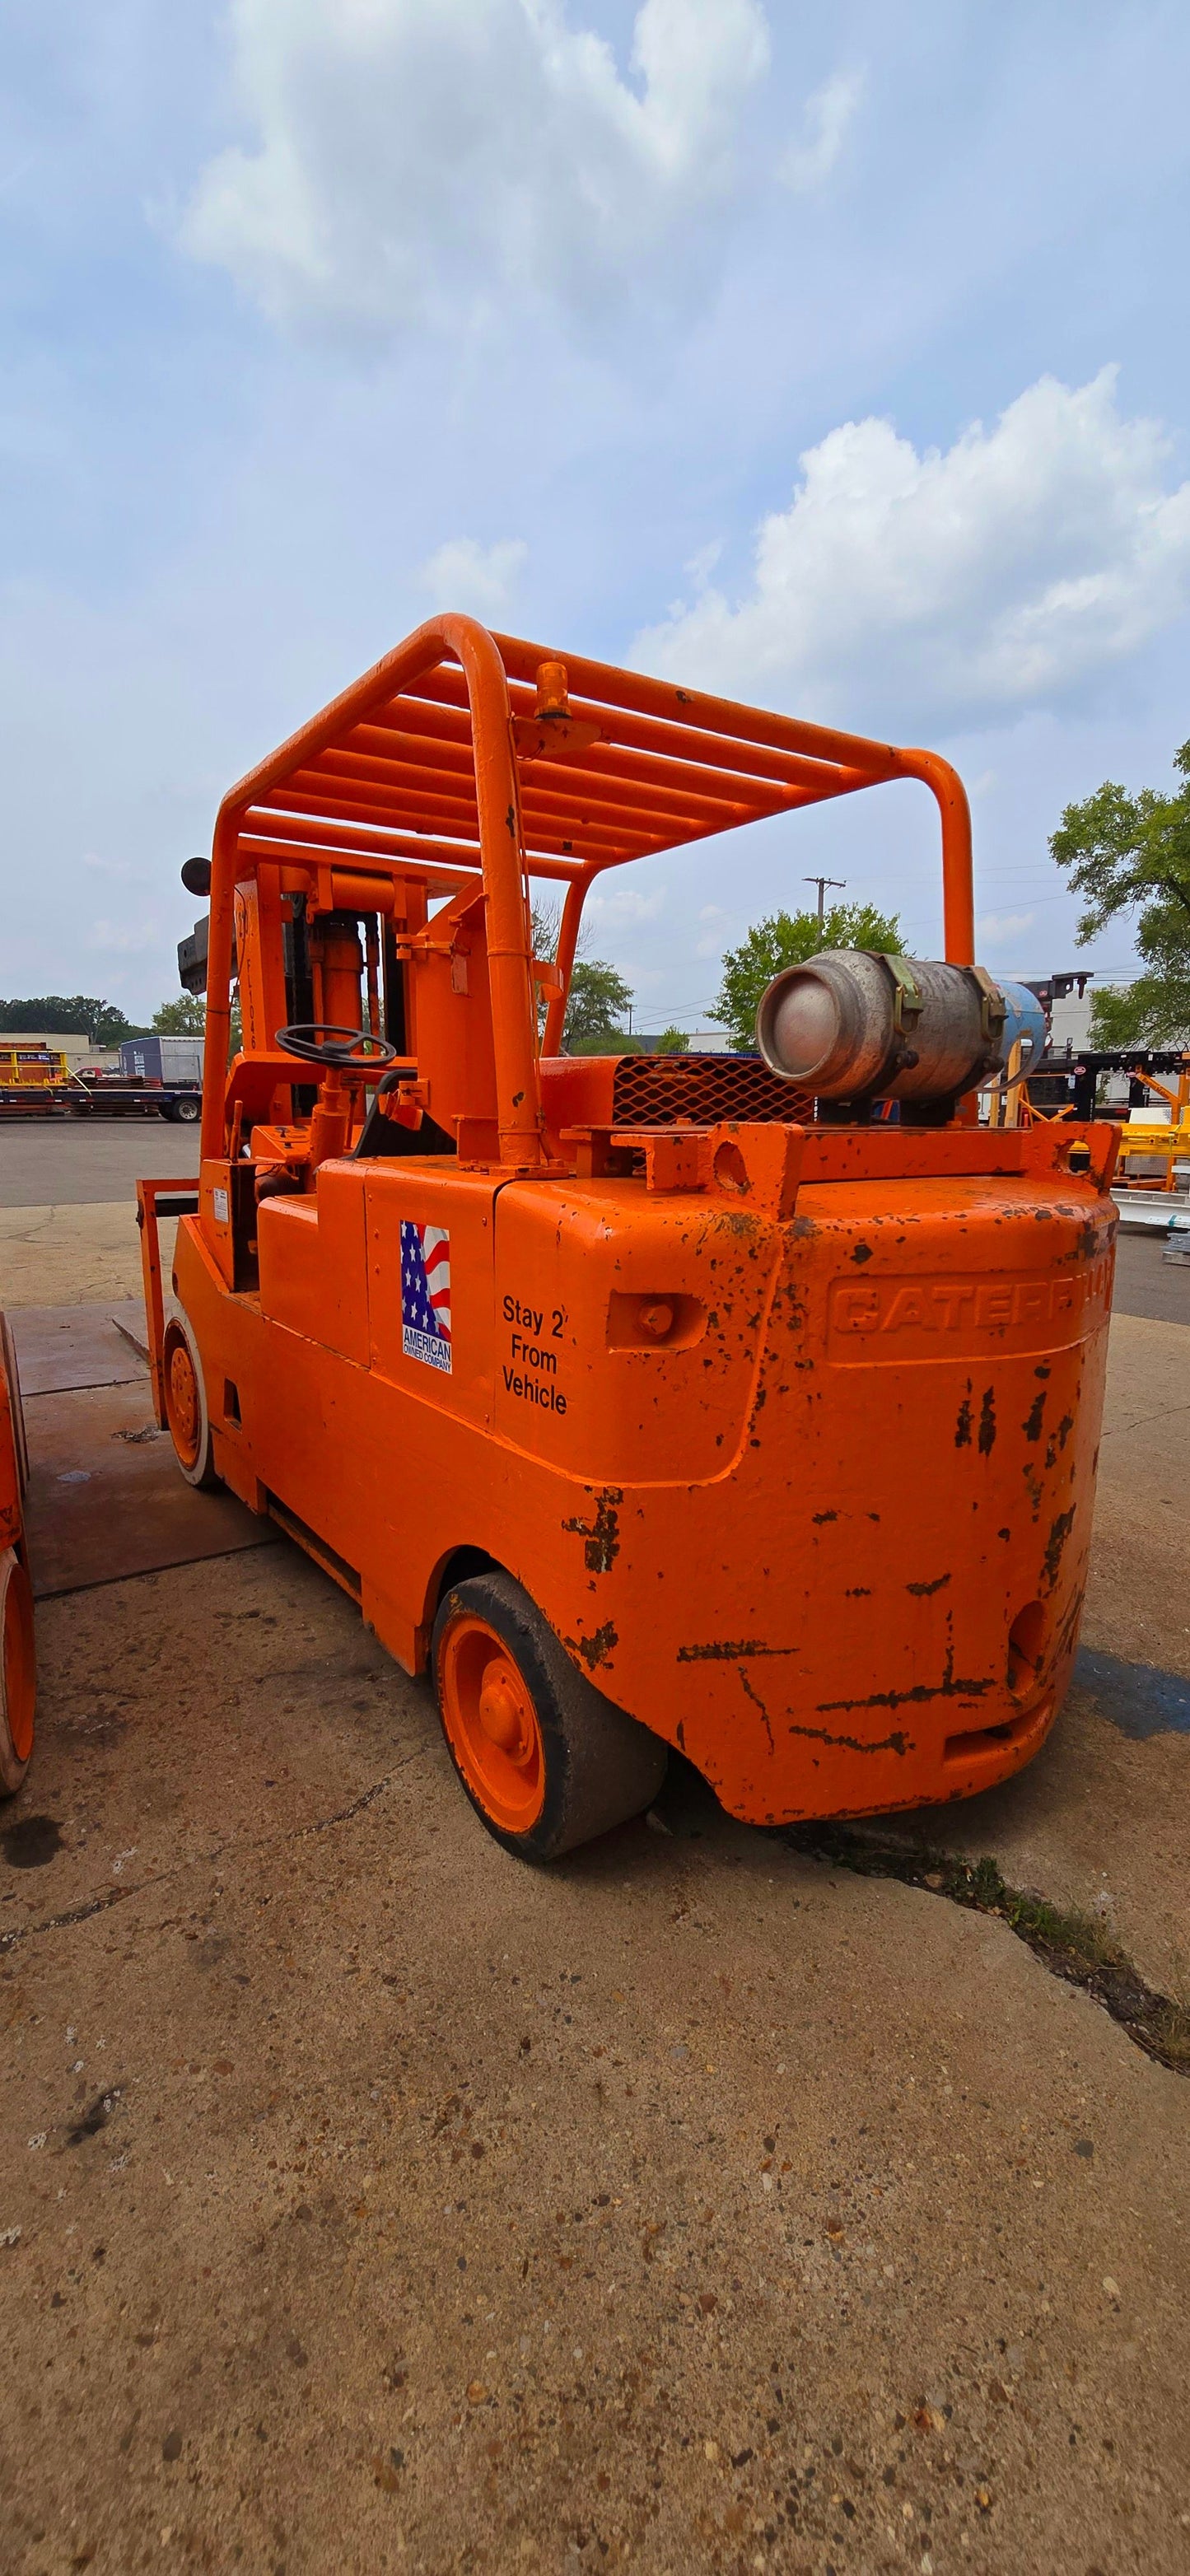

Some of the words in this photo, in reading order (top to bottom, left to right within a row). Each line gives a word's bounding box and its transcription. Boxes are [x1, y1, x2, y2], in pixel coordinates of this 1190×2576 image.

[503, 1295, 544, 1337] Stay
[404, 1328, 451, 1362] AMERICAN
[404, 1344, 423, 1360] OWNED
[423, 1352, 451, 1373] COMPANY
[511, 1333, 557, 1374] From
[503, 1365, 567, 1416] Vehicle
